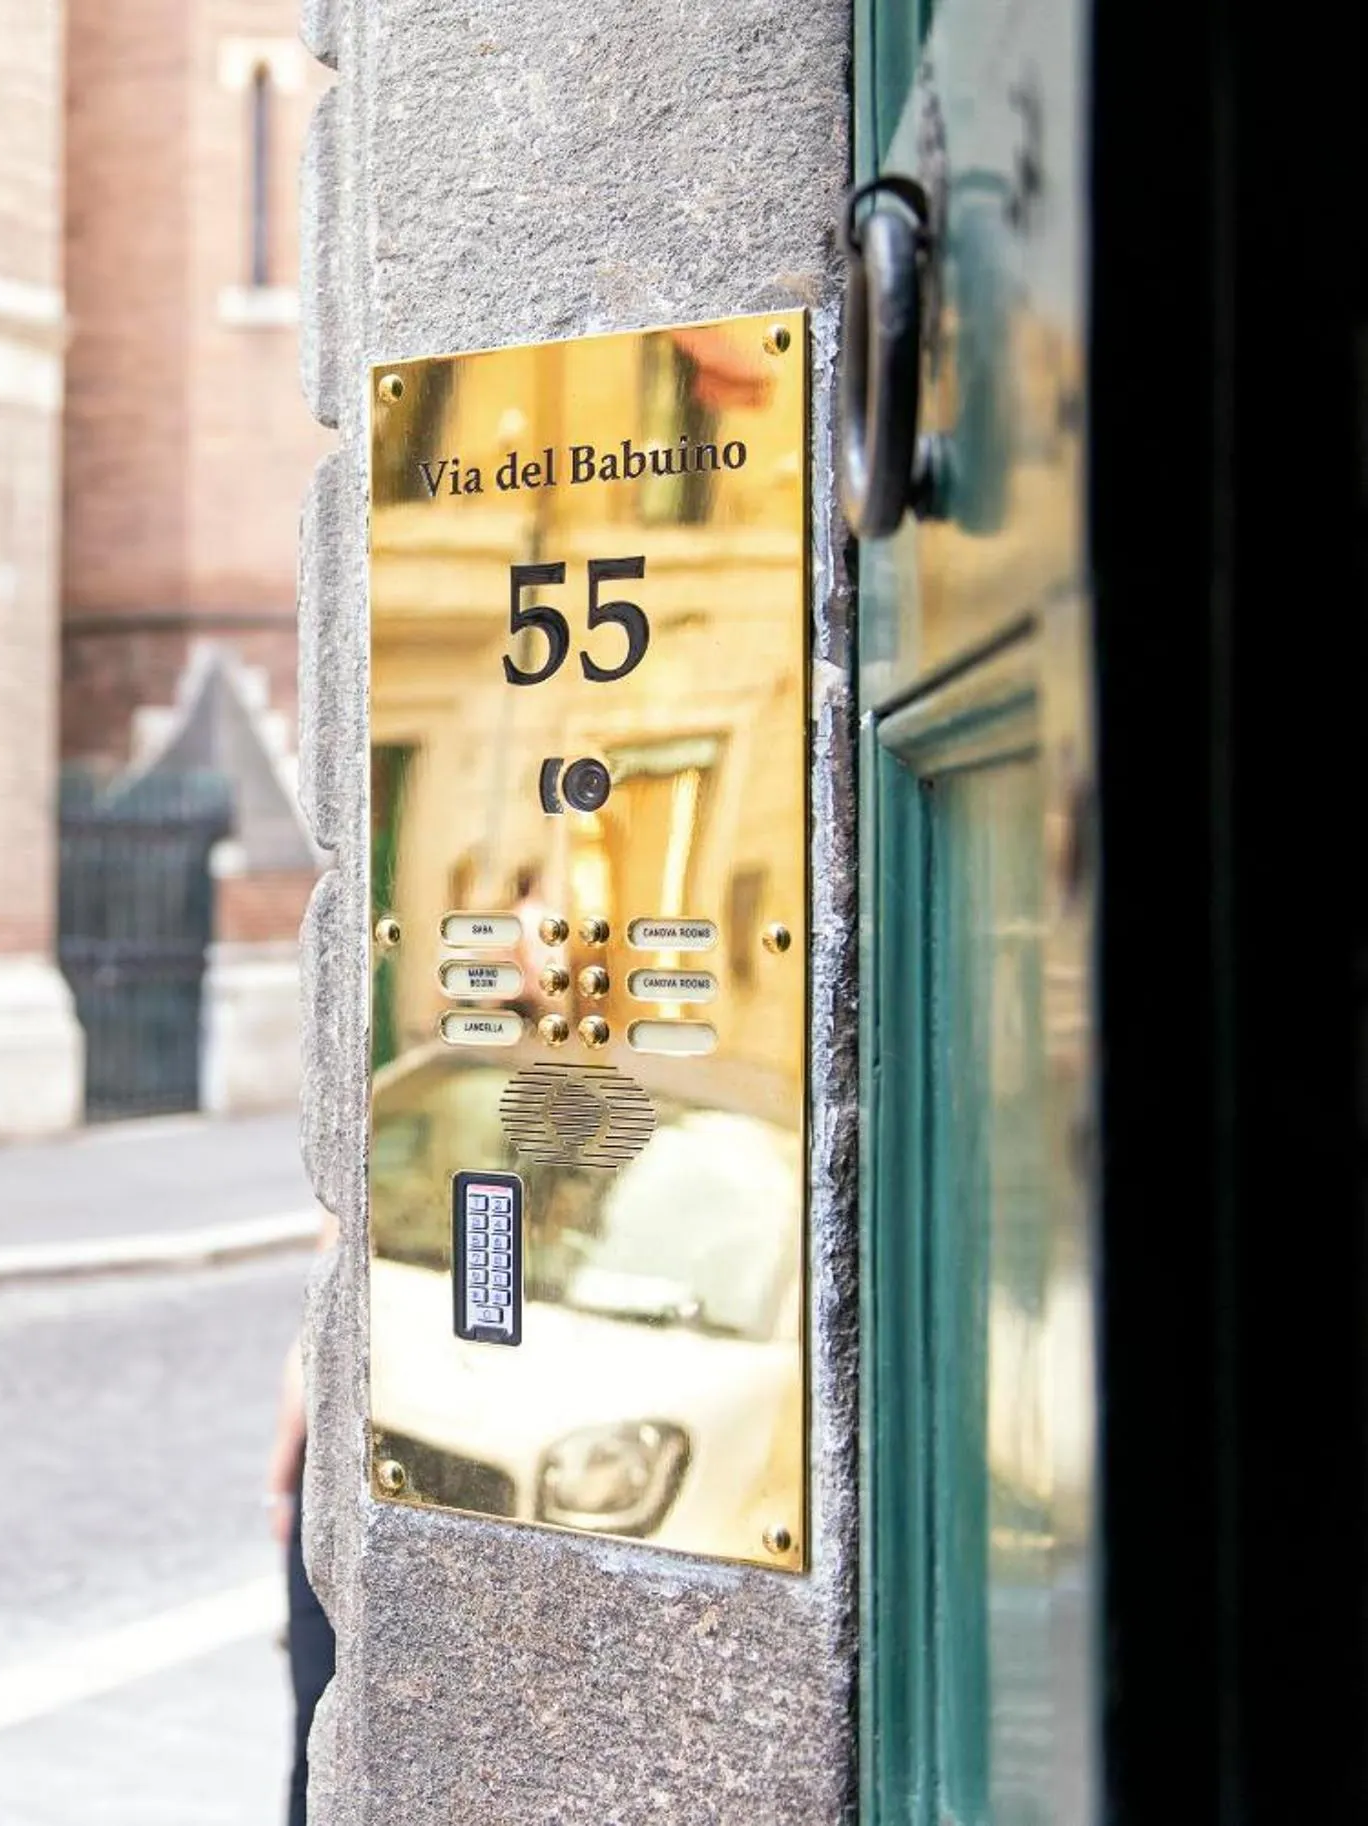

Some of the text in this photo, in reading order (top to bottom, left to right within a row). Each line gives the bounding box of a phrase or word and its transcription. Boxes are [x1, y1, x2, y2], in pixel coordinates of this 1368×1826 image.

[417, 435, 748, 497] Via del Babuino
[501, 555, 650, 686] 55
[643, 927, 711, 939] CANOVA ROOMS
[643, 977, 711, 989] CANOVA ROOMS
